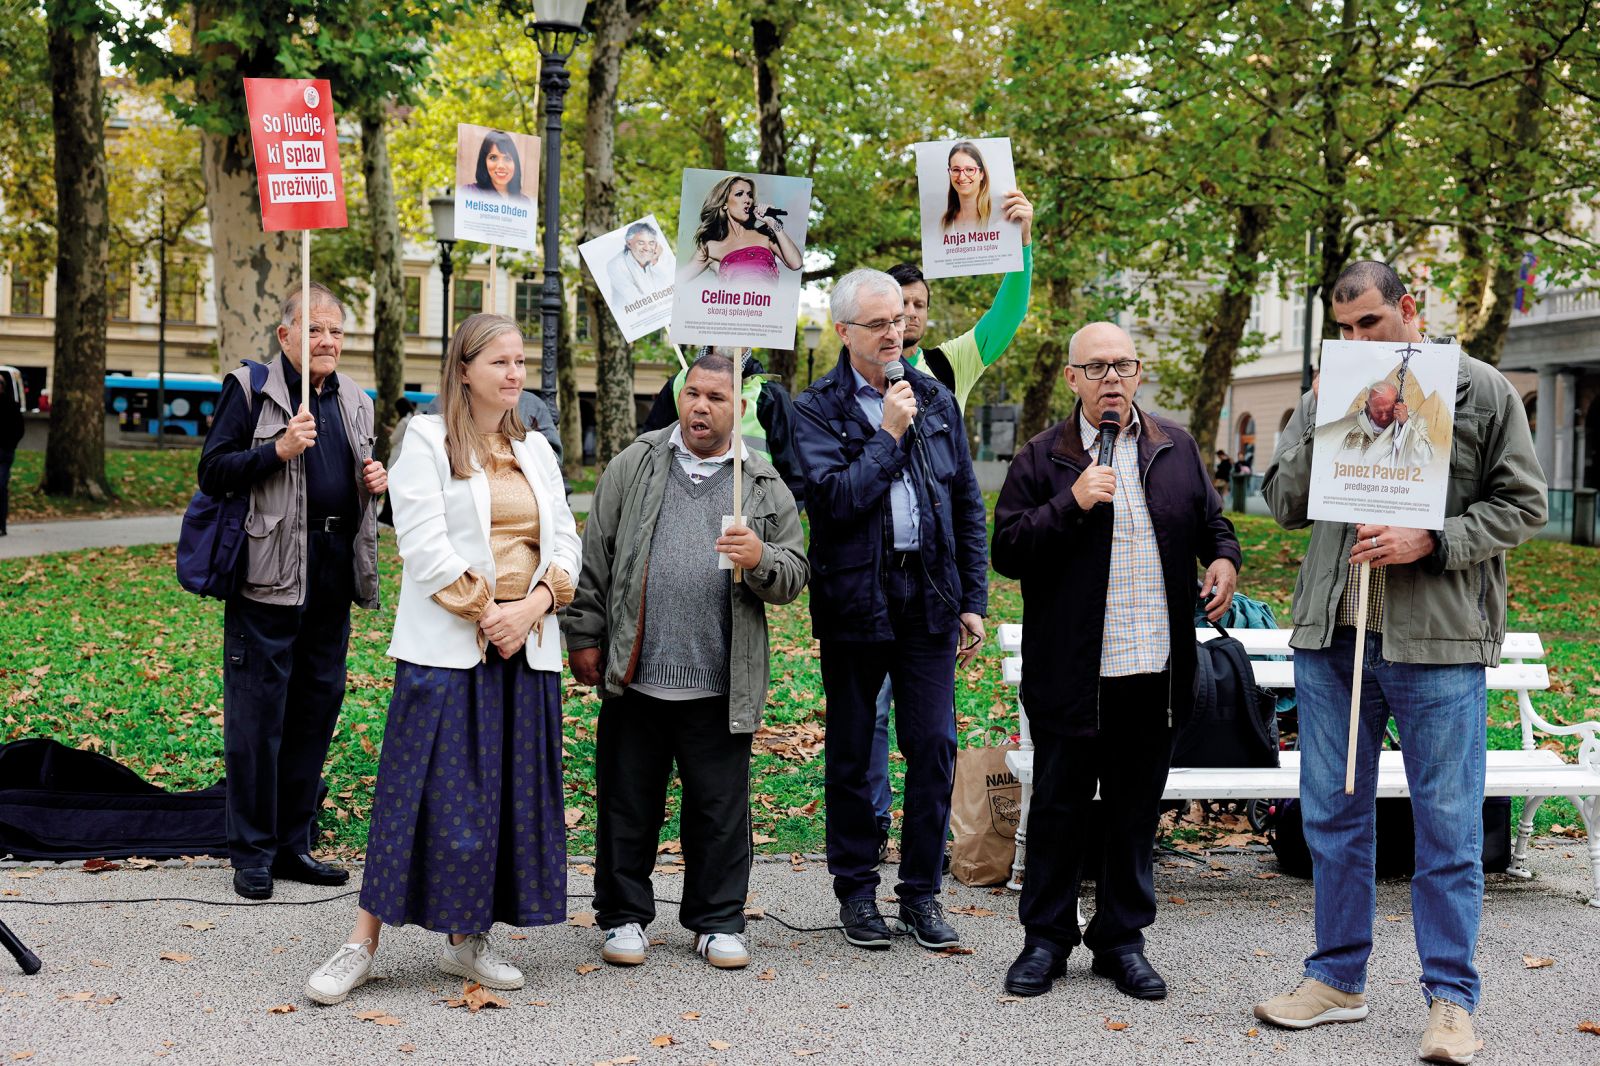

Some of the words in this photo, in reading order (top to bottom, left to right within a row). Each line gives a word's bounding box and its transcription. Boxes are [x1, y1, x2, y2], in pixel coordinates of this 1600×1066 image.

[263, 113, 281, 133] So
[283, 113, 326, 137] ljudje,
[267, 143, 281, 164] ki
[286, 144, 321, 166] splav
[272, 176, 333, 200] preživijo.
[465, 199, 499, 213] Melissa
[501, 205, 528, 218] Ohden
[943, 233, 966, 246] Anja
[968, 231, 1001, 243] Maver
[983, 243, 999, 252] splav
[623, 296, 653, 315] Andrea
[701, 289, 741, 305] Celine
[743, 291, 771, 307] Dion
[707, 307, 728, 316] skoraj
[729, 308, 763, 318] splavljena
[1333, 461, 1370, 480] Janez
[1372, 464, 1410, 481] Pavel
[1411, 467, 1424, 483] 2.
[1344, 482, 1380, 493] predlagan
[1380, 485, 1389, 493] za
[1389, 485, 1410, 495] splav
